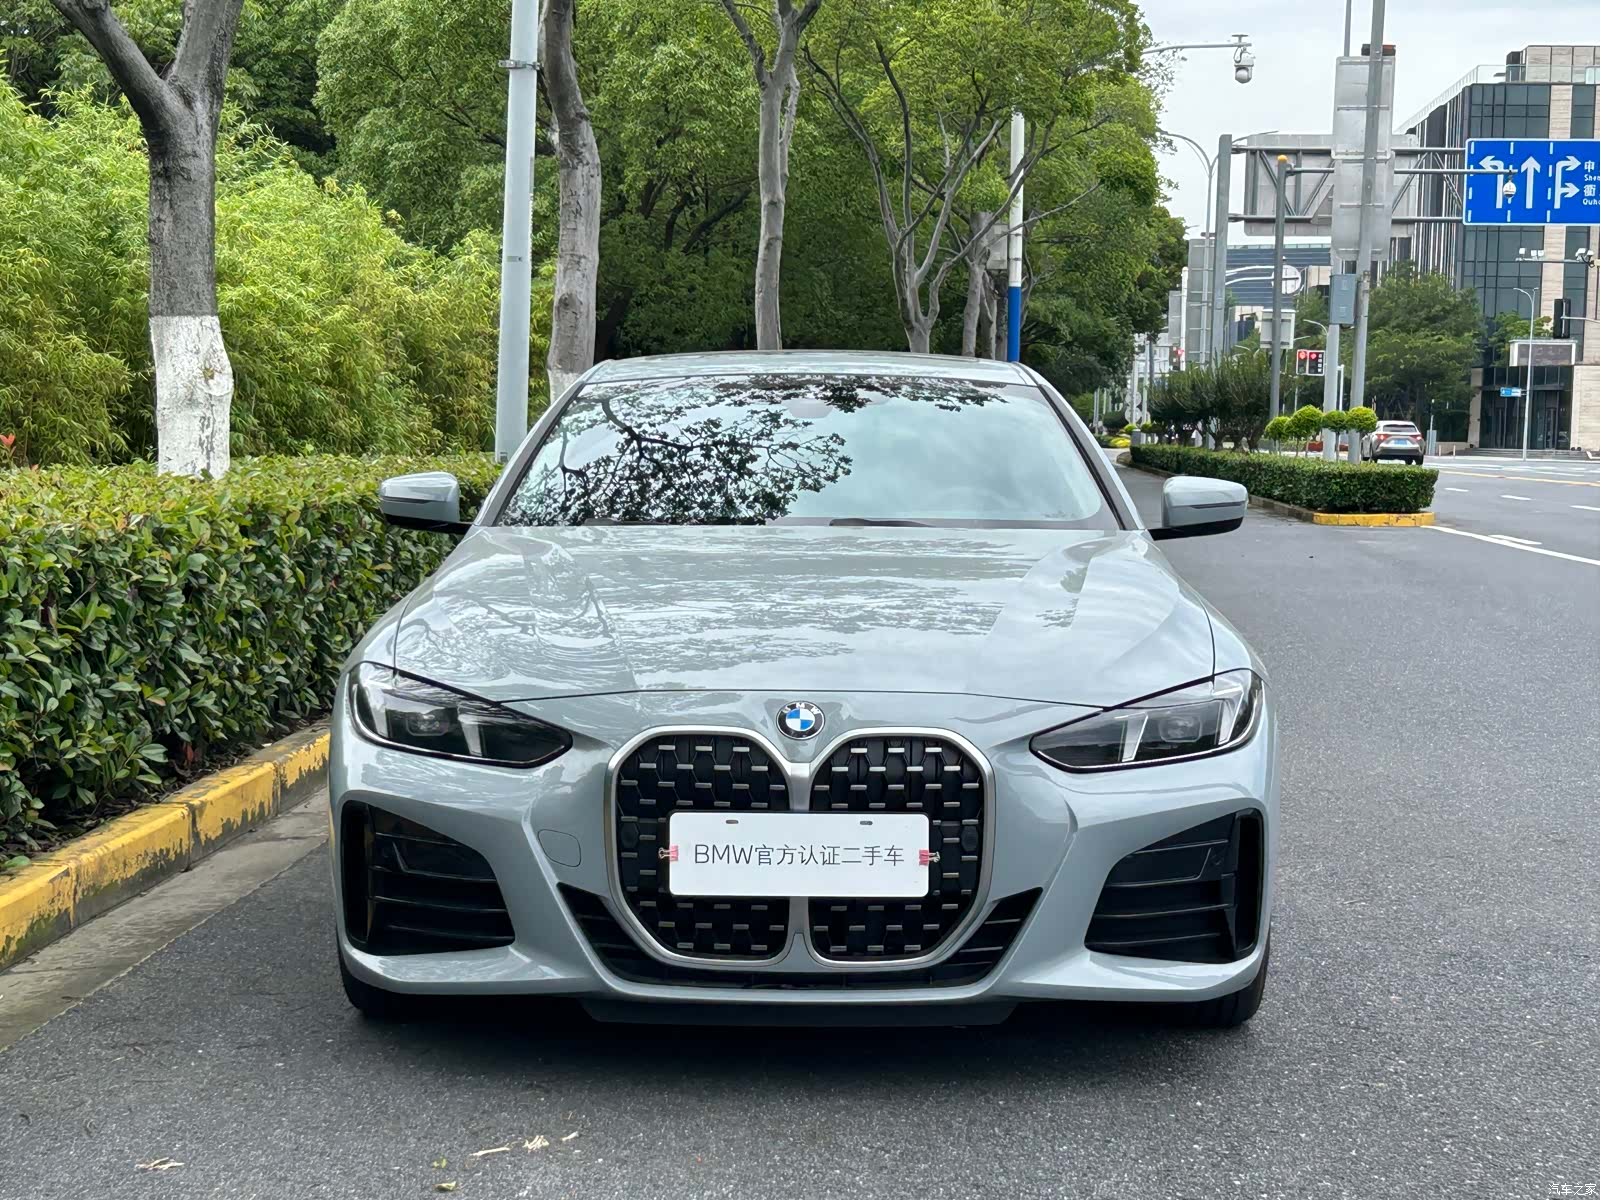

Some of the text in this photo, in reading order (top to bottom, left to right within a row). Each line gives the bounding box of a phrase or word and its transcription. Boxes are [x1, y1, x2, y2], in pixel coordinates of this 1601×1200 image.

[1584, 160, 1595, 173] 申
[694, 844, 904, 866] BMW官方认证二手车
